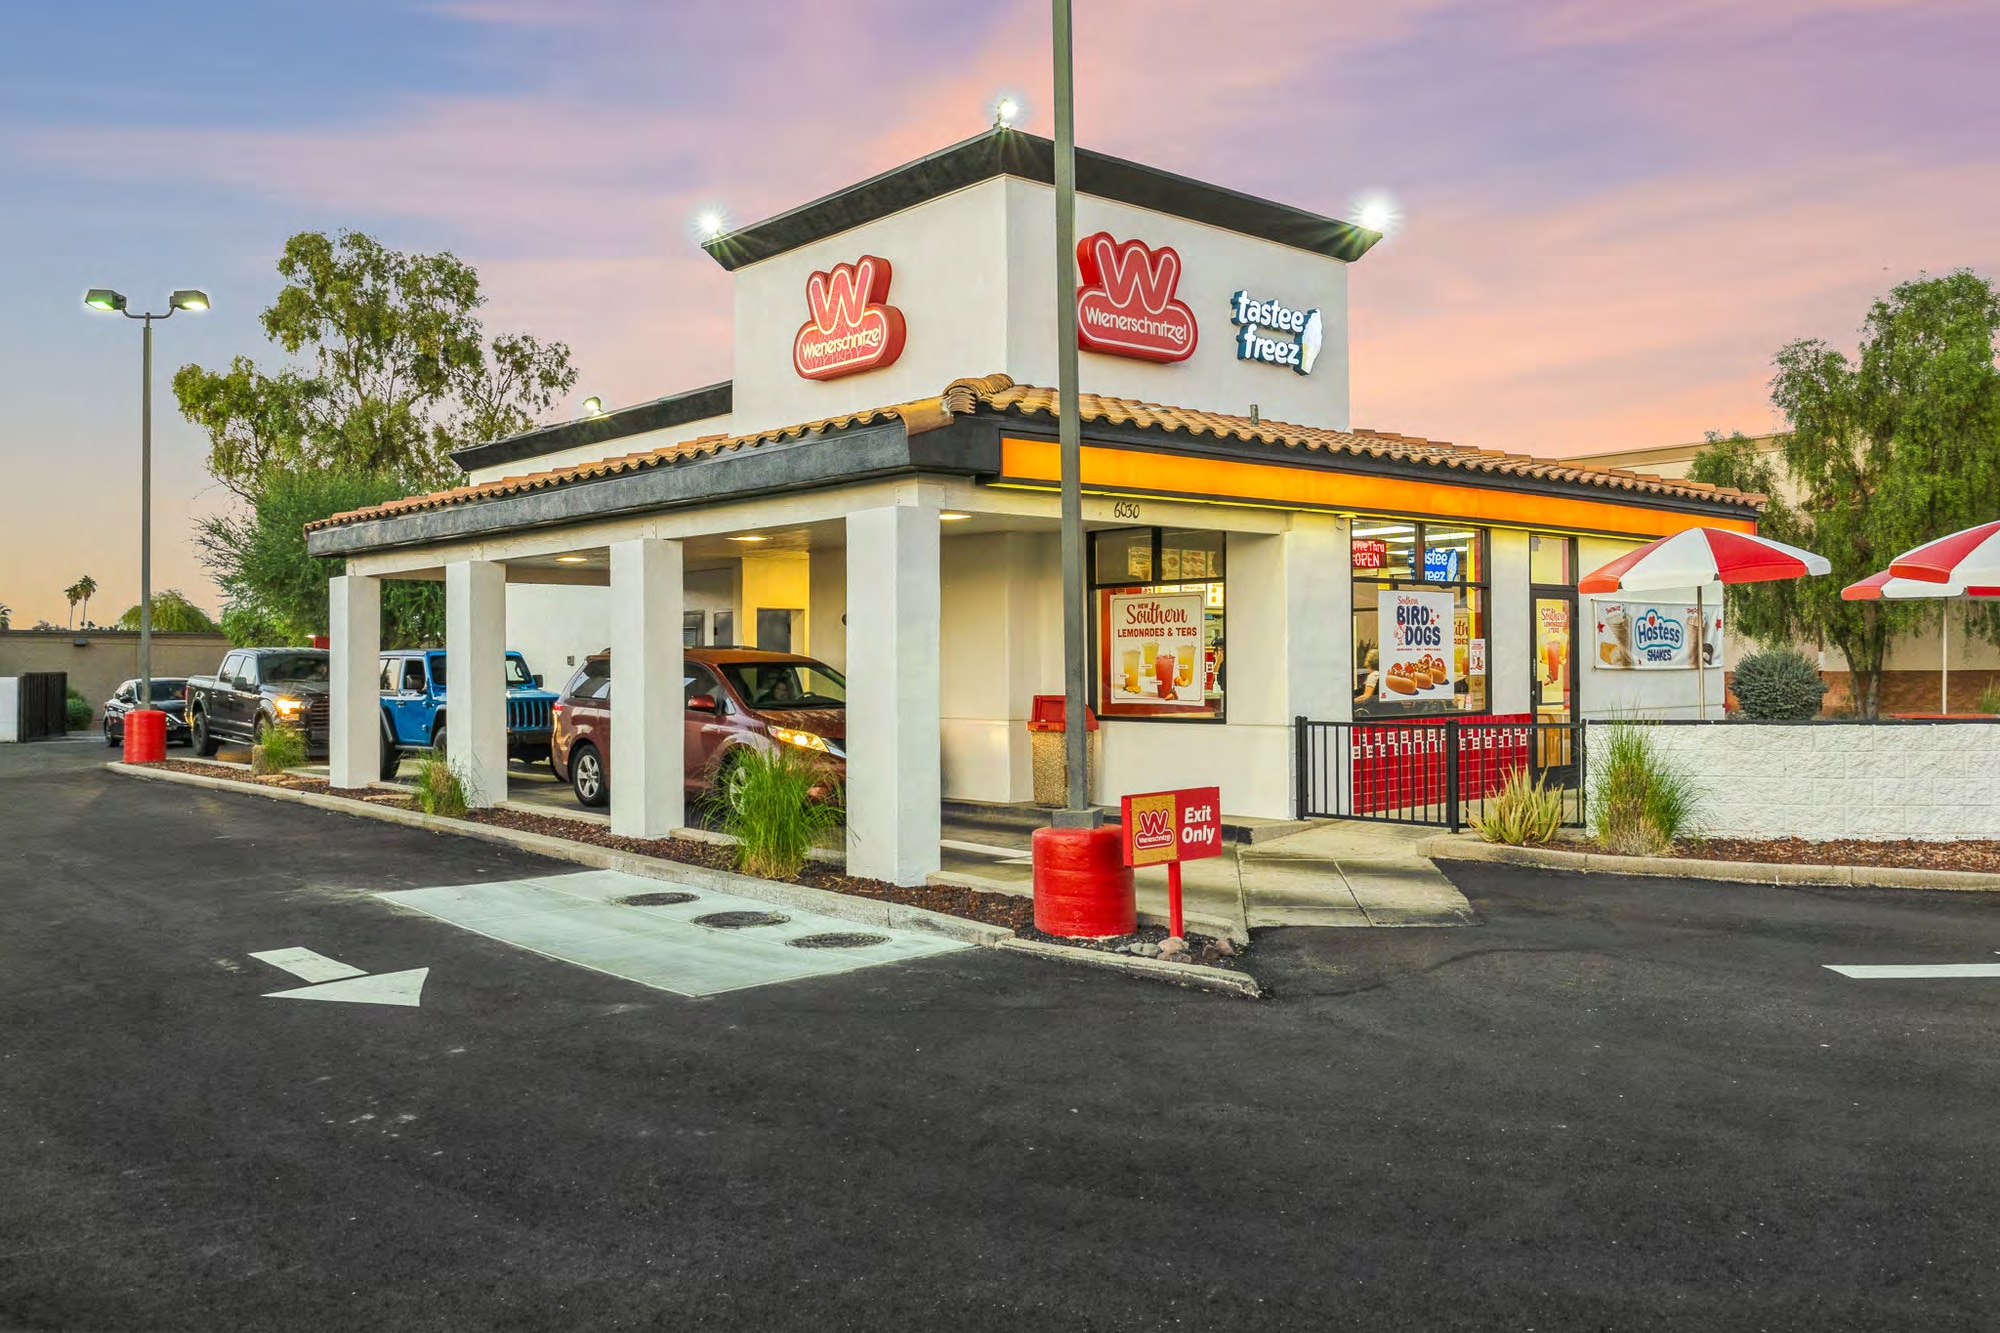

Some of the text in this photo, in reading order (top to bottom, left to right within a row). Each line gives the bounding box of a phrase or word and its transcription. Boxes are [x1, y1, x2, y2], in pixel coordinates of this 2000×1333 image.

[1096, 239, 1177, 315] W
[809, 260, 872, 335] W
[1238, 289, 1304, 333] tastee
[1085, 305, 1187, 345] Wienerschnitzel
[802, 323, 882, 360] Wienerschnitzel
[1244, 323, 1300, 366] freez
[1114, 501, 1141, 519] 6030
[1368, 541, 1385, 552] Thru
[1354, 552, 1380, 566] OPEN
[1126, 601, 1188, 625] Southern
[1396, 605, 1430, 626] BIRD
[1117, 626, 1198, 638] LEMONADES & TEAS
[1404, 626, 1441, 646] DOGS
[1638, 622, 1680, 643] Hostess
[1647, 649, 1672, 661] SHAKES
[1139, 810, 1168, 836] W
[1184, 805, 1212, 824] Exit
[1181, 824, 1216, 845] Only
